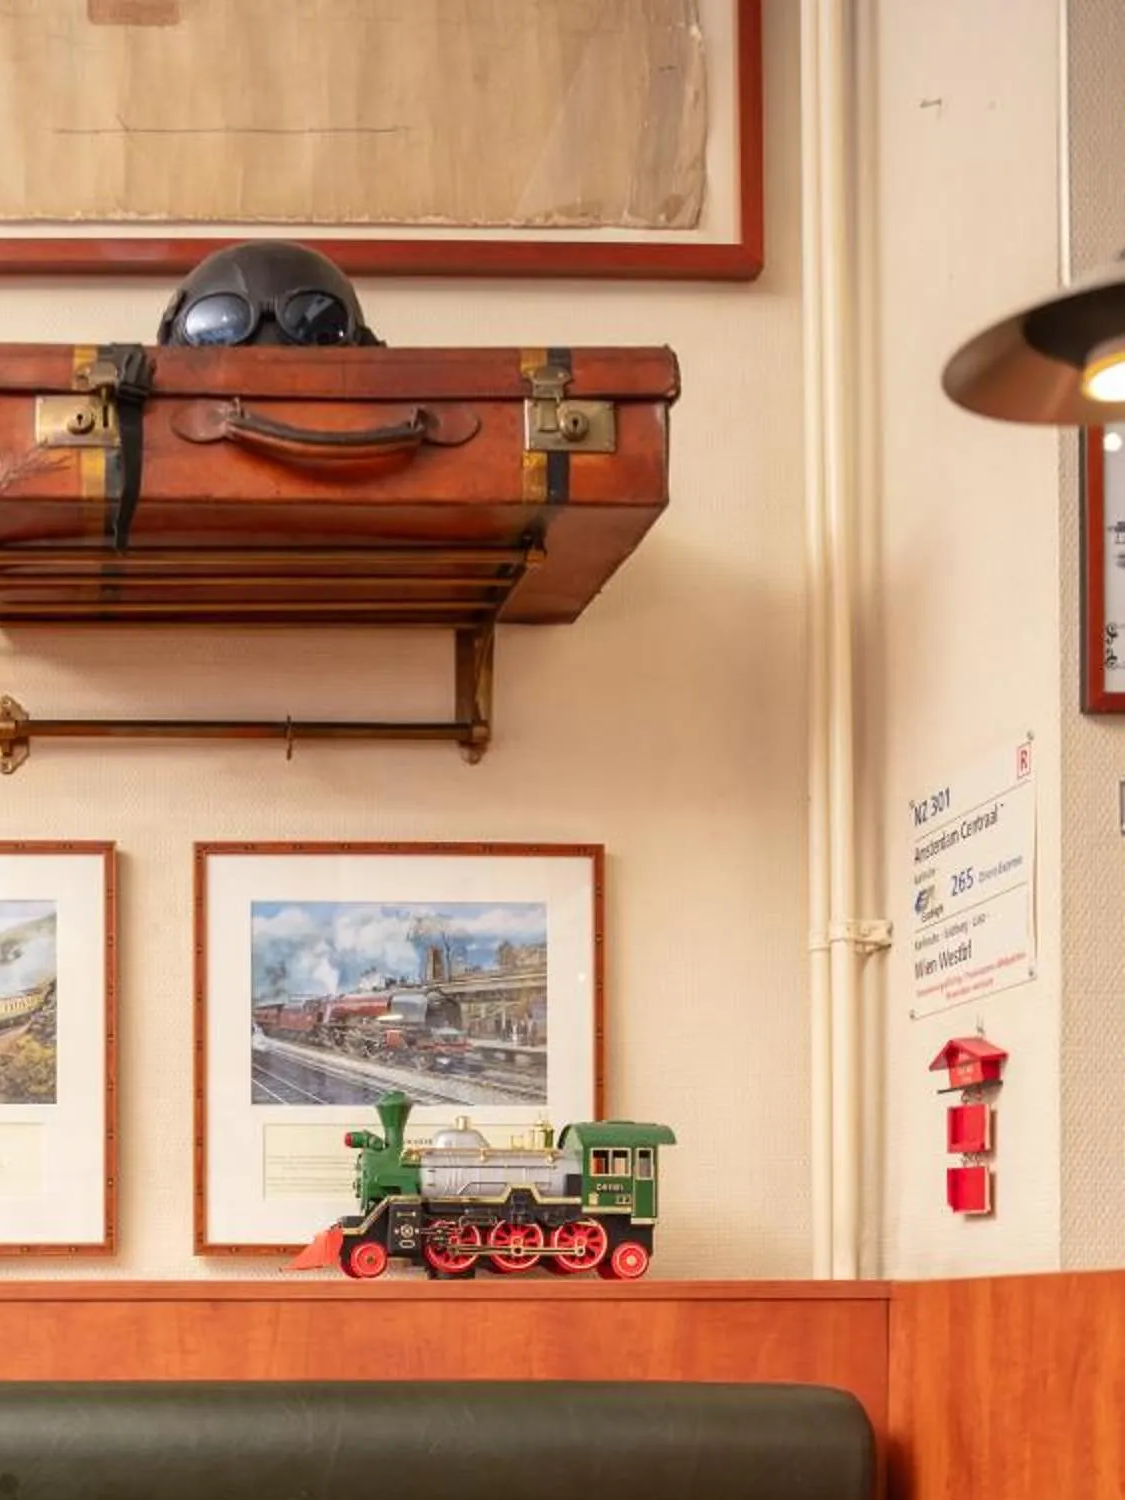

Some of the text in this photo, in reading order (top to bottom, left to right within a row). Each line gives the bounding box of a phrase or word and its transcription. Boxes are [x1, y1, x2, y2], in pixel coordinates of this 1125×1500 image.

[931, 787, 950, 817] 301
[914, 804, 998, 862] Amsterdam Centraal
[952, 867, 974, 896] 265
[915, 959, 937, 980] Wien
